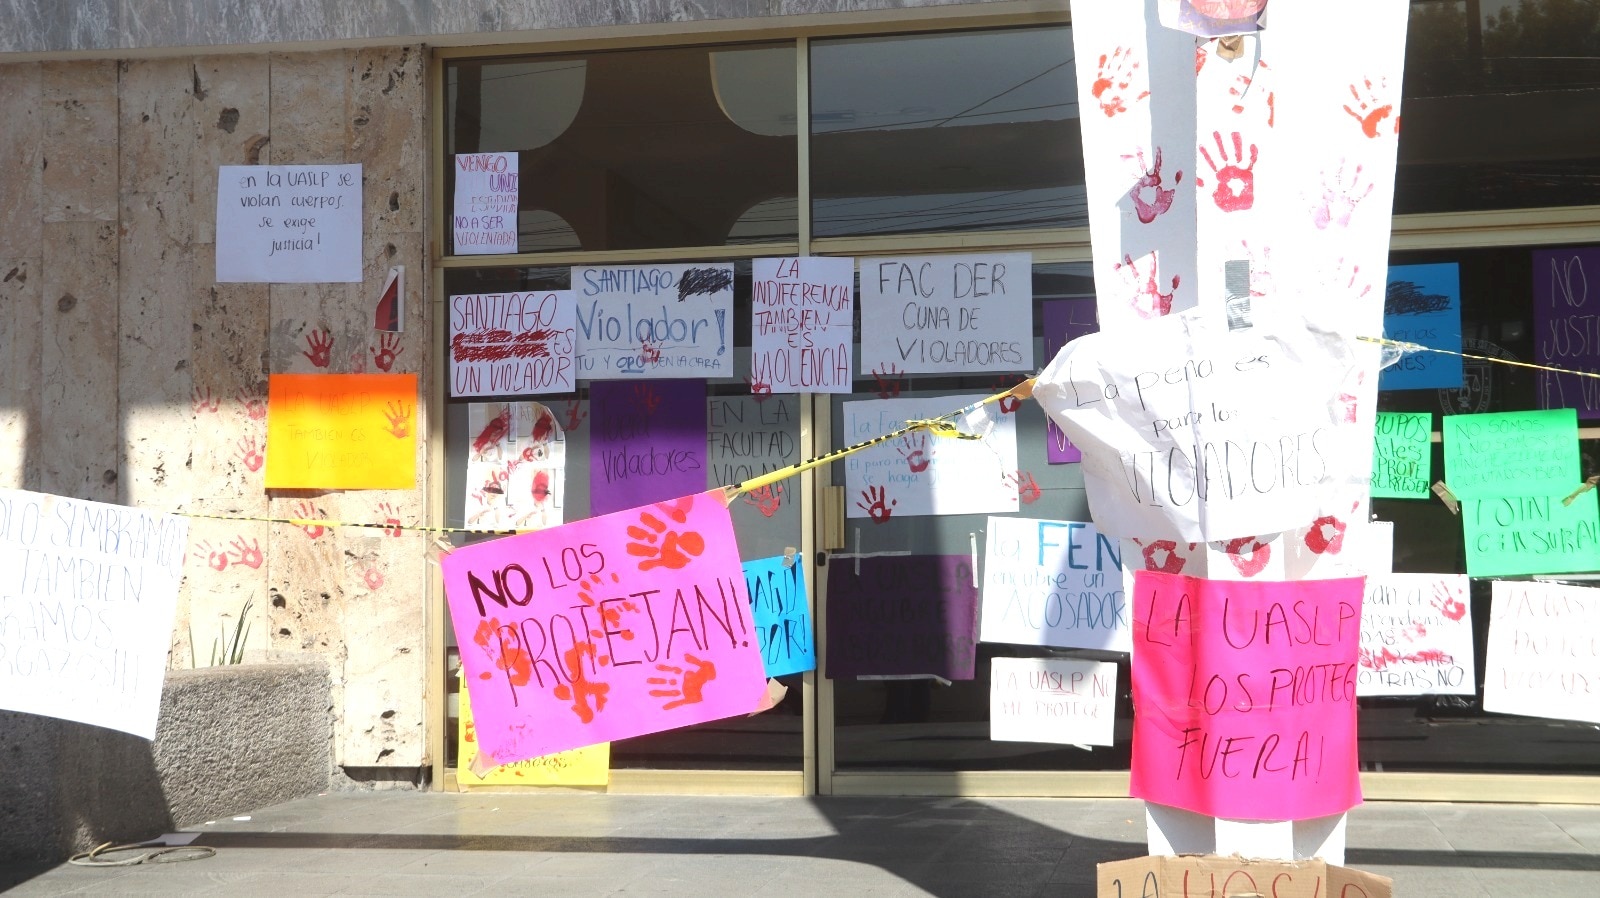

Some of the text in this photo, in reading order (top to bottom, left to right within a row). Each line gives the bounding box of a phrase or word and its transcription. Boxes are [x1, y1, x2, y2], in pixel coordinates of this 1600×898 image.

[457, 154, 508, 174] VENGO
[266, 171, 281, 187] la
[287, 171, 329, 188] UASLP
[338, 172, 354, 187] se
[240, 194, 344, 209] violan cuerpos.
[258, 216, 316, 235] se exige
[456, 215, 504, 229] NO A SER
[583, 269, 673, 296] SANTIAGO
[776, 258, 799, 279] LA
[879, 262, 1006, 299] FAC DER
[1550, 256, 1587, 307] NO
[753, 281, 850, 312] INDIFERENCIA
[453, 294, 558, 331] SANTIAGO
[903, 302, 981, 331] CUNA DE
[554, 329, 575, 355] ES
[788, 331, 815, 349] ES
[896, 337, 1023, 365] VIOLADORES
[456, 357, 570, 394] UN VIOLADOR
[575, 355, 594, 370] TU
[604, 355, 611, 368] Y
[689, 356, 721, 369] CARA
[751, 343, 848, 387] VIOLENCIA
[1070, 360, 1121, 407] La
[1234, 354, 1270, 372] es
[709, 399, 790, 427] EN LA
[708, 431, 793, 460] FACULTAD
[18, 549, 144, 603] TAMBIEN
[467, 543, 605, 617] NO LOS
[1083, 572, 1104, 588] un
[1146, 590, 1355, 649] LA UASLP
[496, 577, 749, 707] PROTEJAN!
[1029, 670, 1084, 691] UASLP
[1187, 663, 1254, 715] LOS
[1437, 665, 1464, 689] NO
